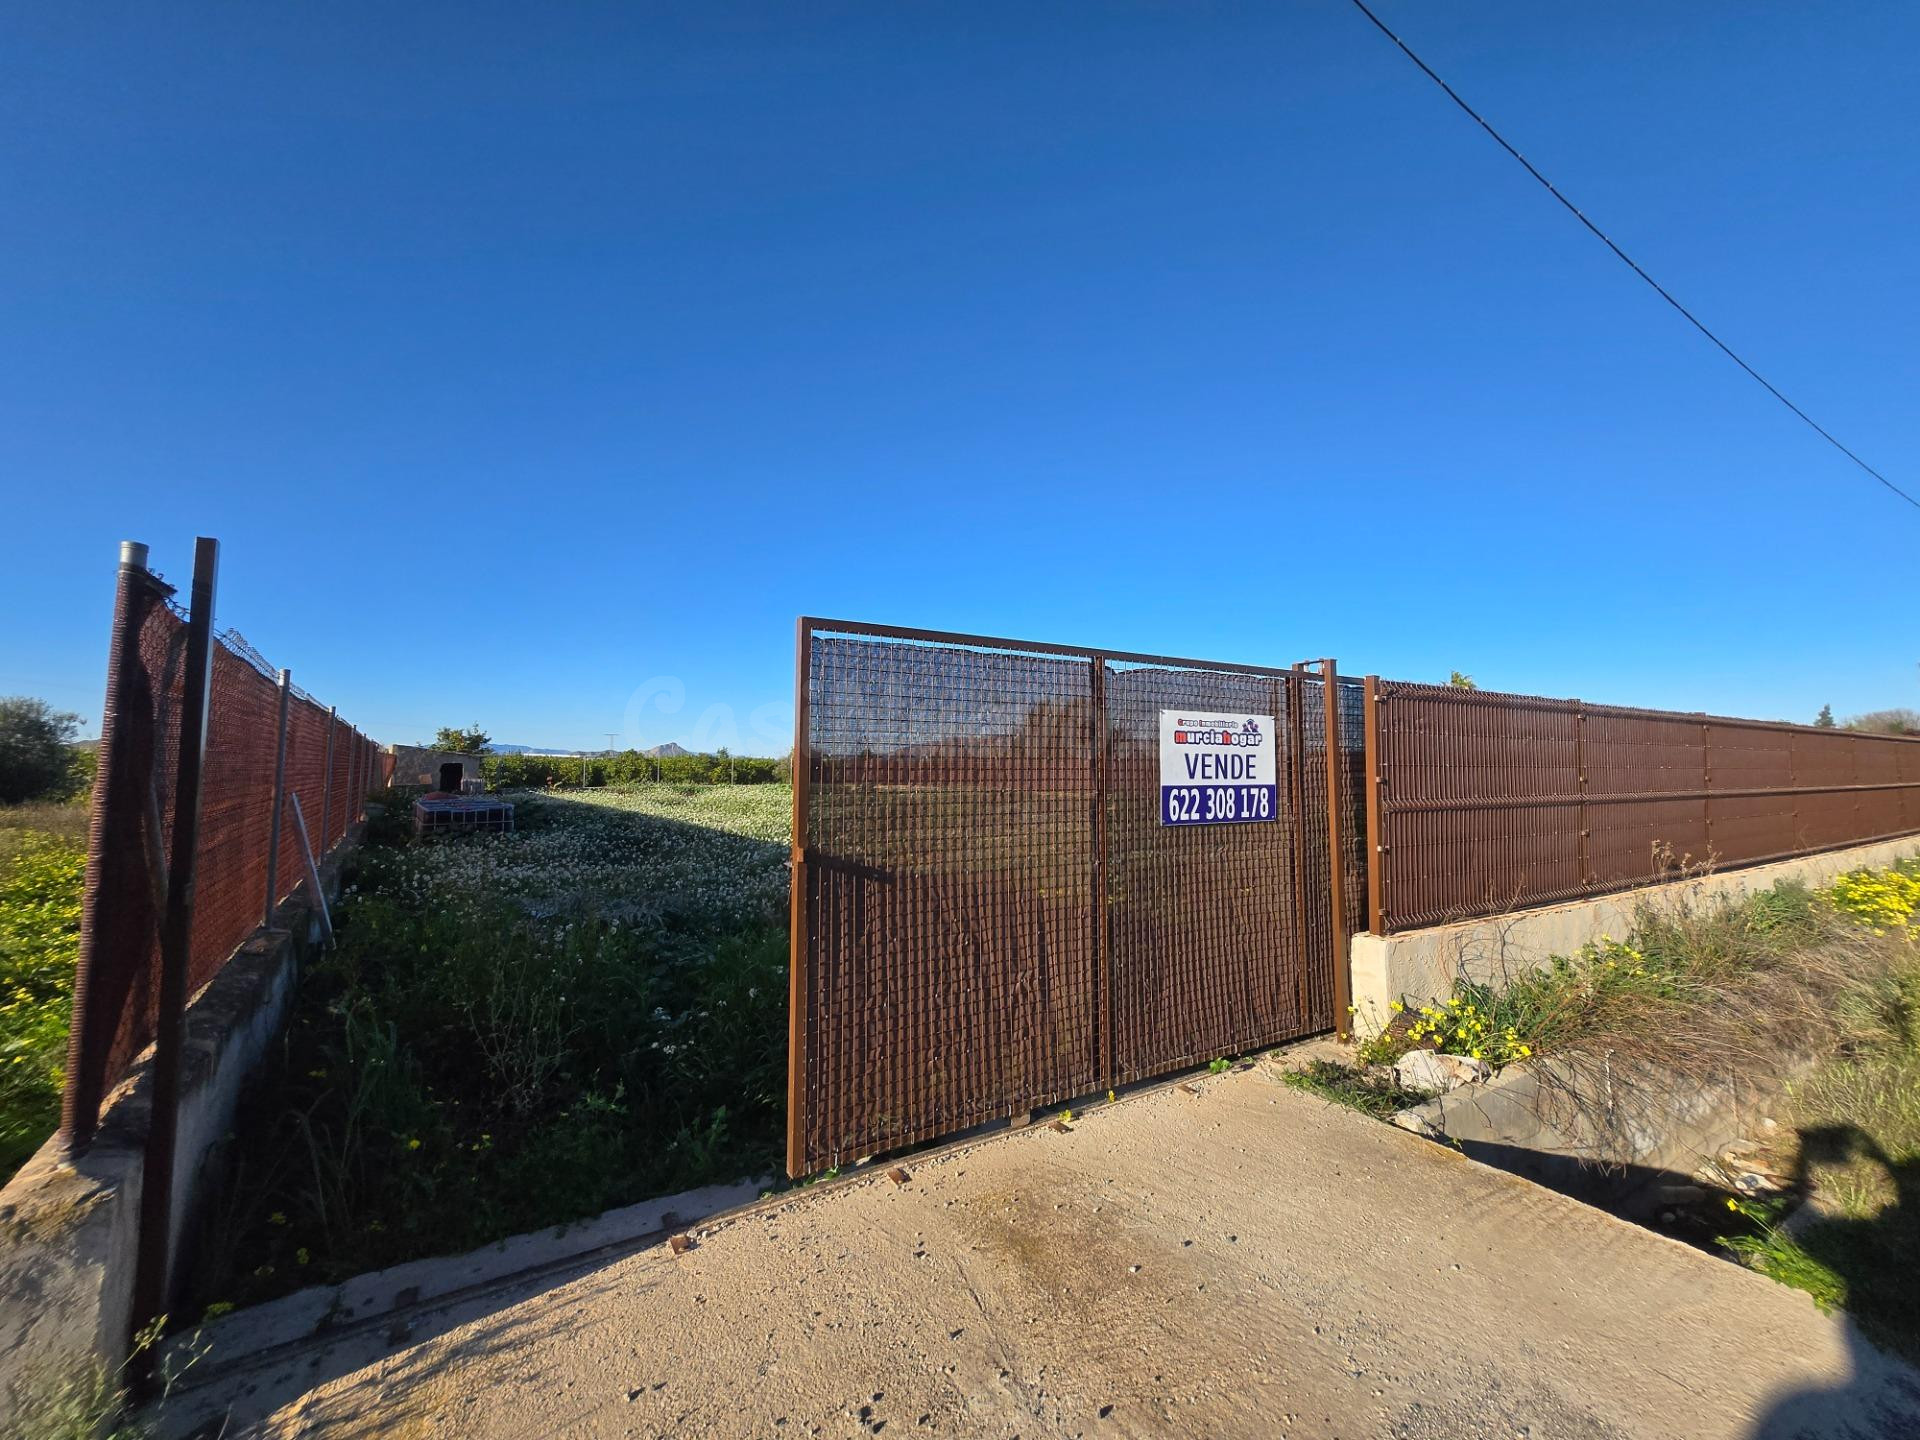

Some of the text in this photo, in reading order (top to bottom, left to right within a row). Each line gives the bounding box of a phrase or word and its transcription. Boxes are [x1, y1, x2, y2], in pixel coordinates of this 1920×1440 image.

[1174, 729, 1263, 747] murciahogar
[1184, 753, 1257, 780] VENDE
[1169, 787, 1269, 822] 622 308 178
